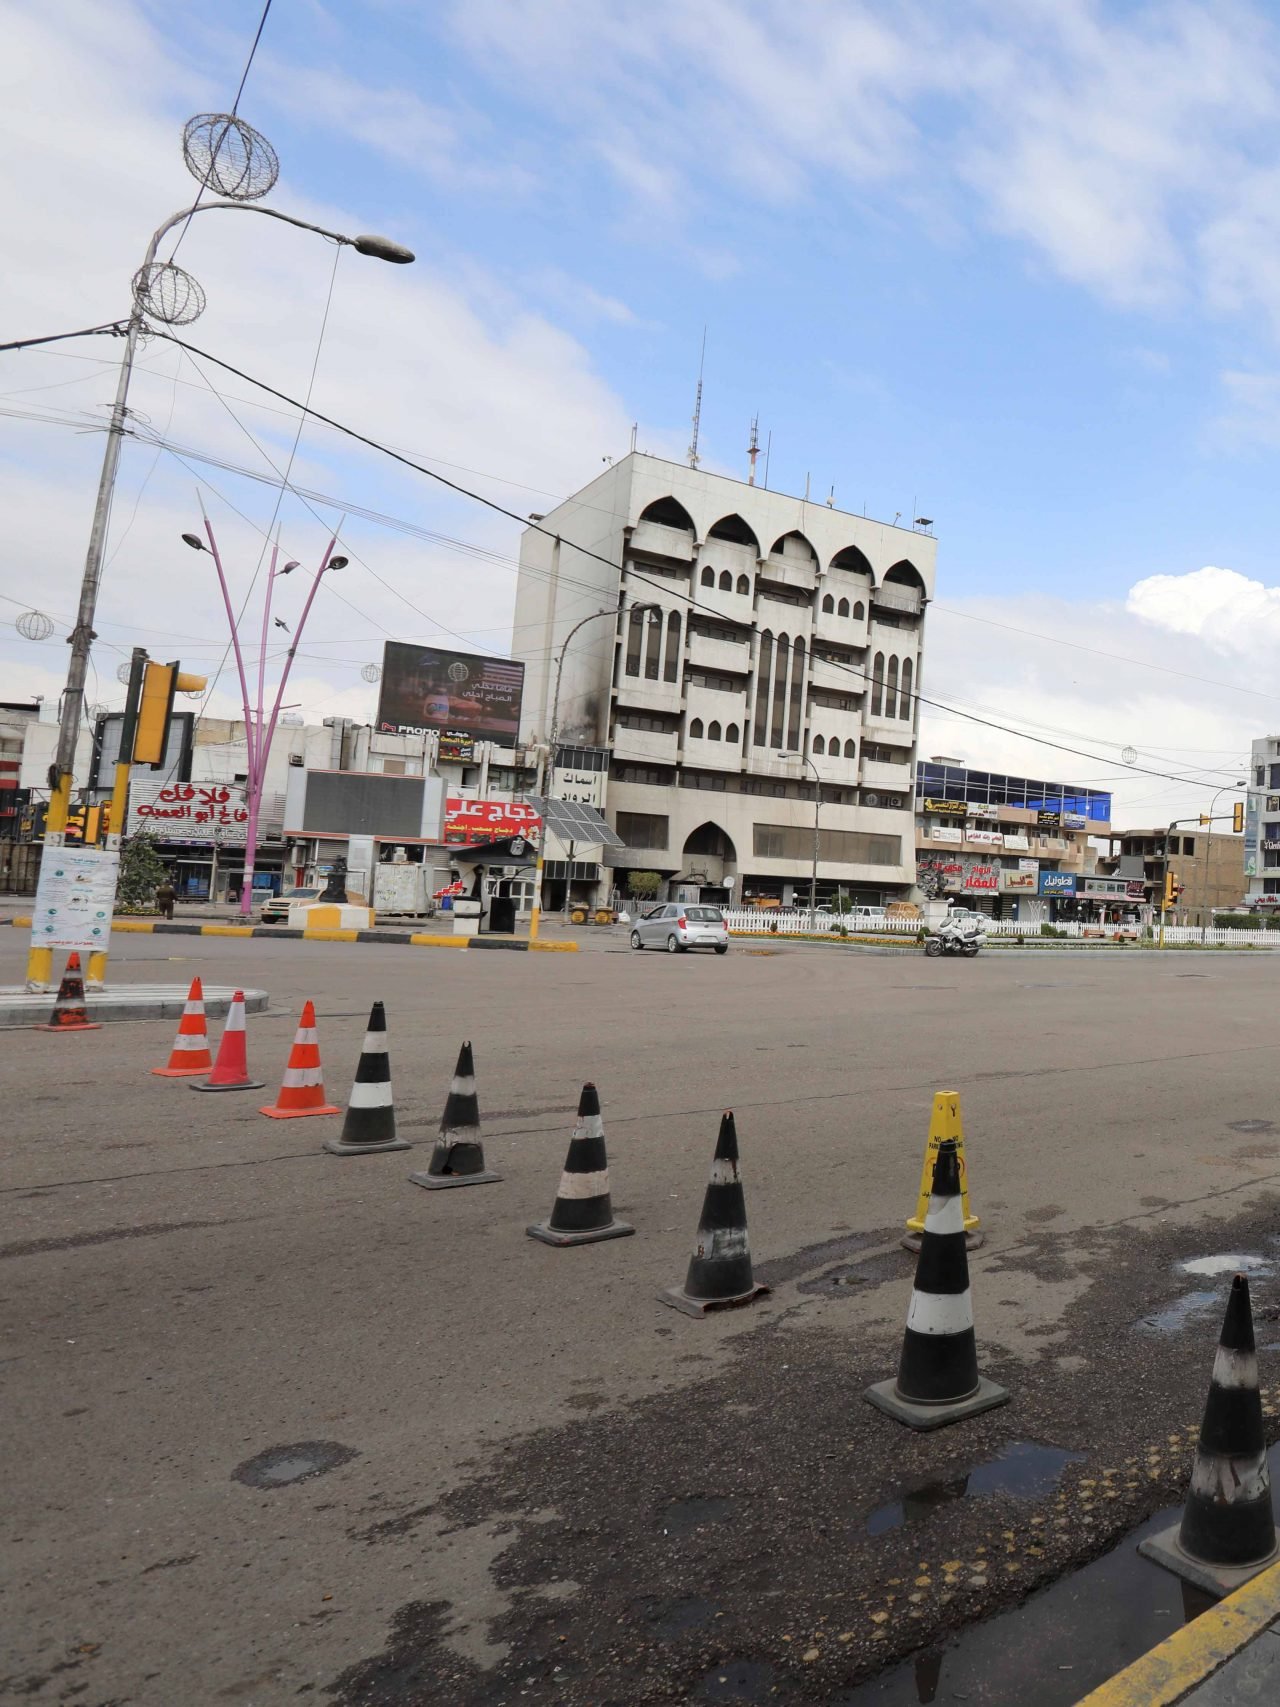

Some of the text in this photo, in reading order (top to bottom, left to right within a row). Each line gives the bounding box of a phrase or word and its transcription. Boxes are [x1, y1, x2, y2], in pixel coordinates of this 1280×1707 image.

[485, 693, 512, 702] الصباح
[563, 772, 597, 785] أسماك
[562, 792, 596, 804] الرواد
[194, 804, 215, 823] أبو
[444, 800, 541, 822] دجاج علي
[1044, 874, 1073, 886] قطونيل
